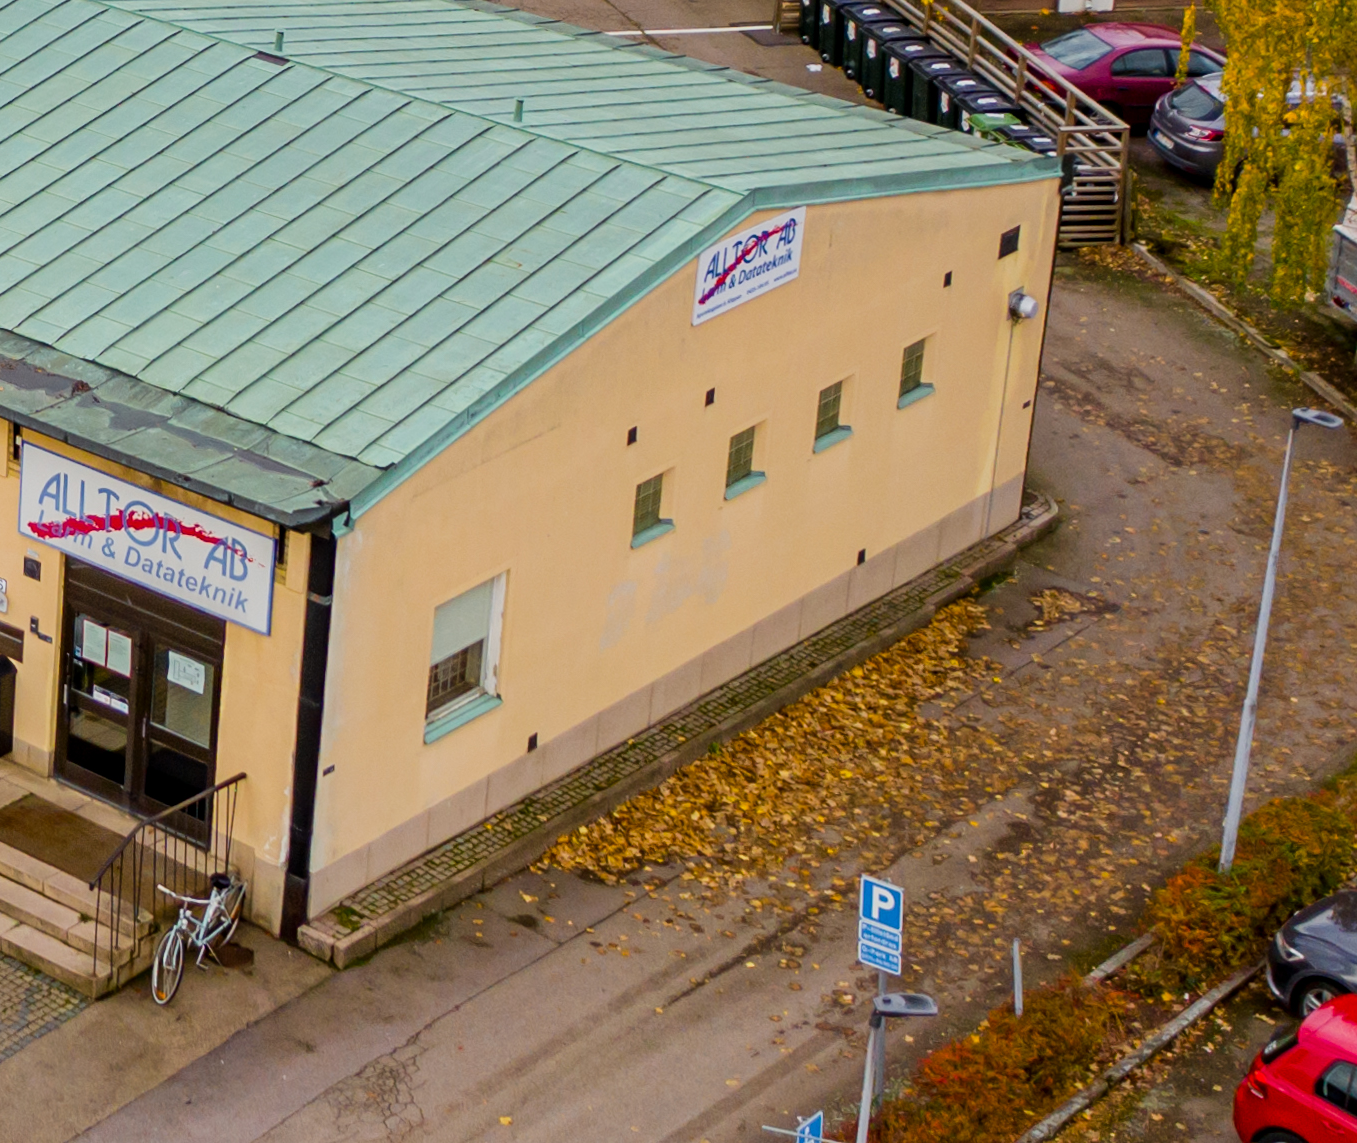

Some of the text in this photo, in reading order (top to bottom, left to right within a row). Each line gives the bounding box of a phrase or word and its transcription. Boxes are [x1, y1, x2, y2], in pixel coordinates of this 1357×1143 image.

[704, 218, 797, 283] ALLTOR AB
[738, 248, 793, 285] Datateknik
[38, 472, 249, 582] ALLTOR AB
[101, 537, 116, 559] &
[124, 546, 248, 613] Datateknik
[871, 885, 895, 920] P
